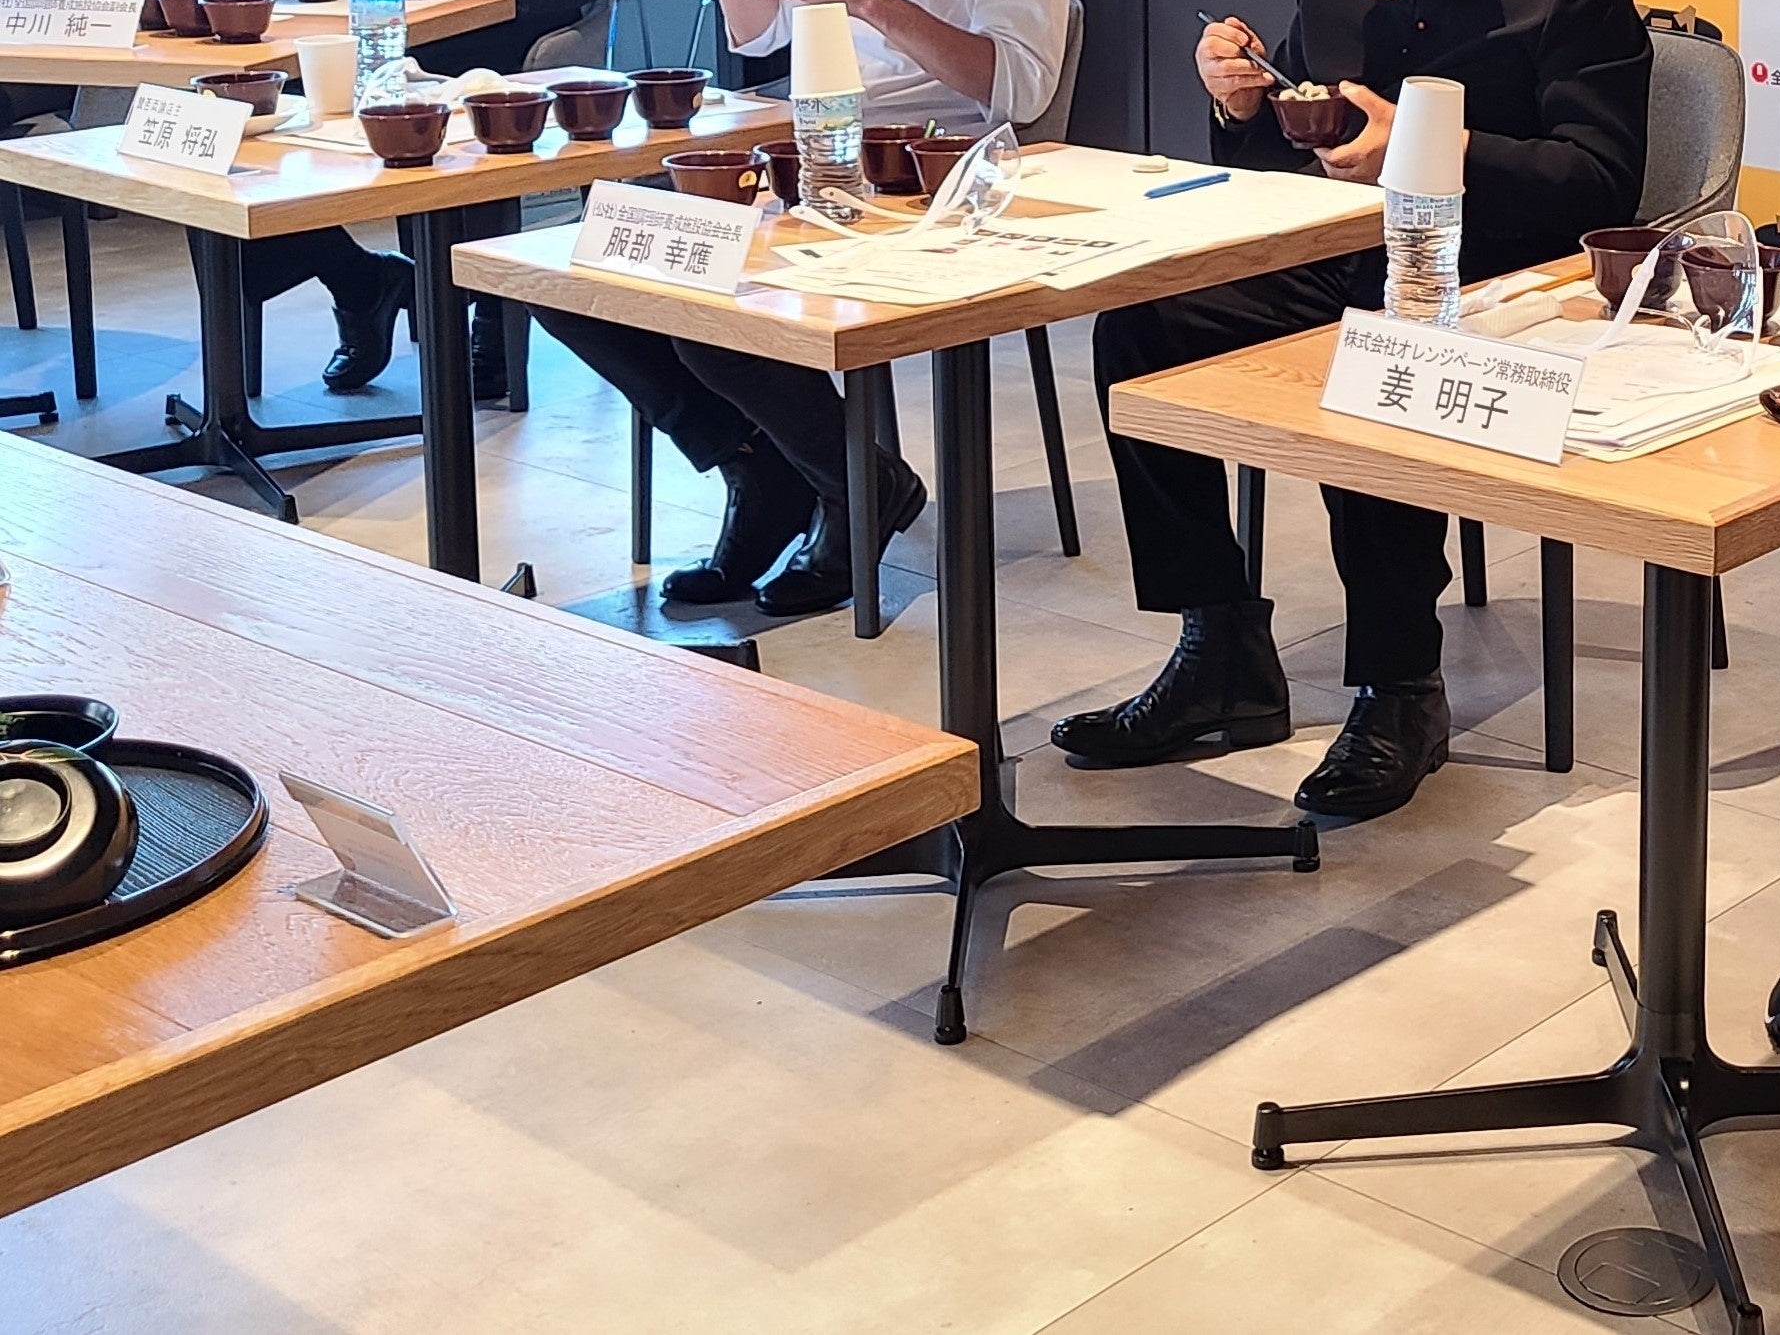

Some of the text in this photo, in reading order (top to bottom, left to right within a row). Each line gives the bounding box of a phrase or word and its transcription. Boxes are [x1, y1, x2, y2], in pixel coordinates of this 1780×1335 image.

[6, 12, 112, 37] 中川 純一
[138, 117, 218, 158] 笠原 将弘
[603, 226, 714, 275] 服部 幸應
[1344, 327, 1573, 395] 株式会社オレンジページ常務取締役
[1378, 364, 1509, 429] 姜 明子
